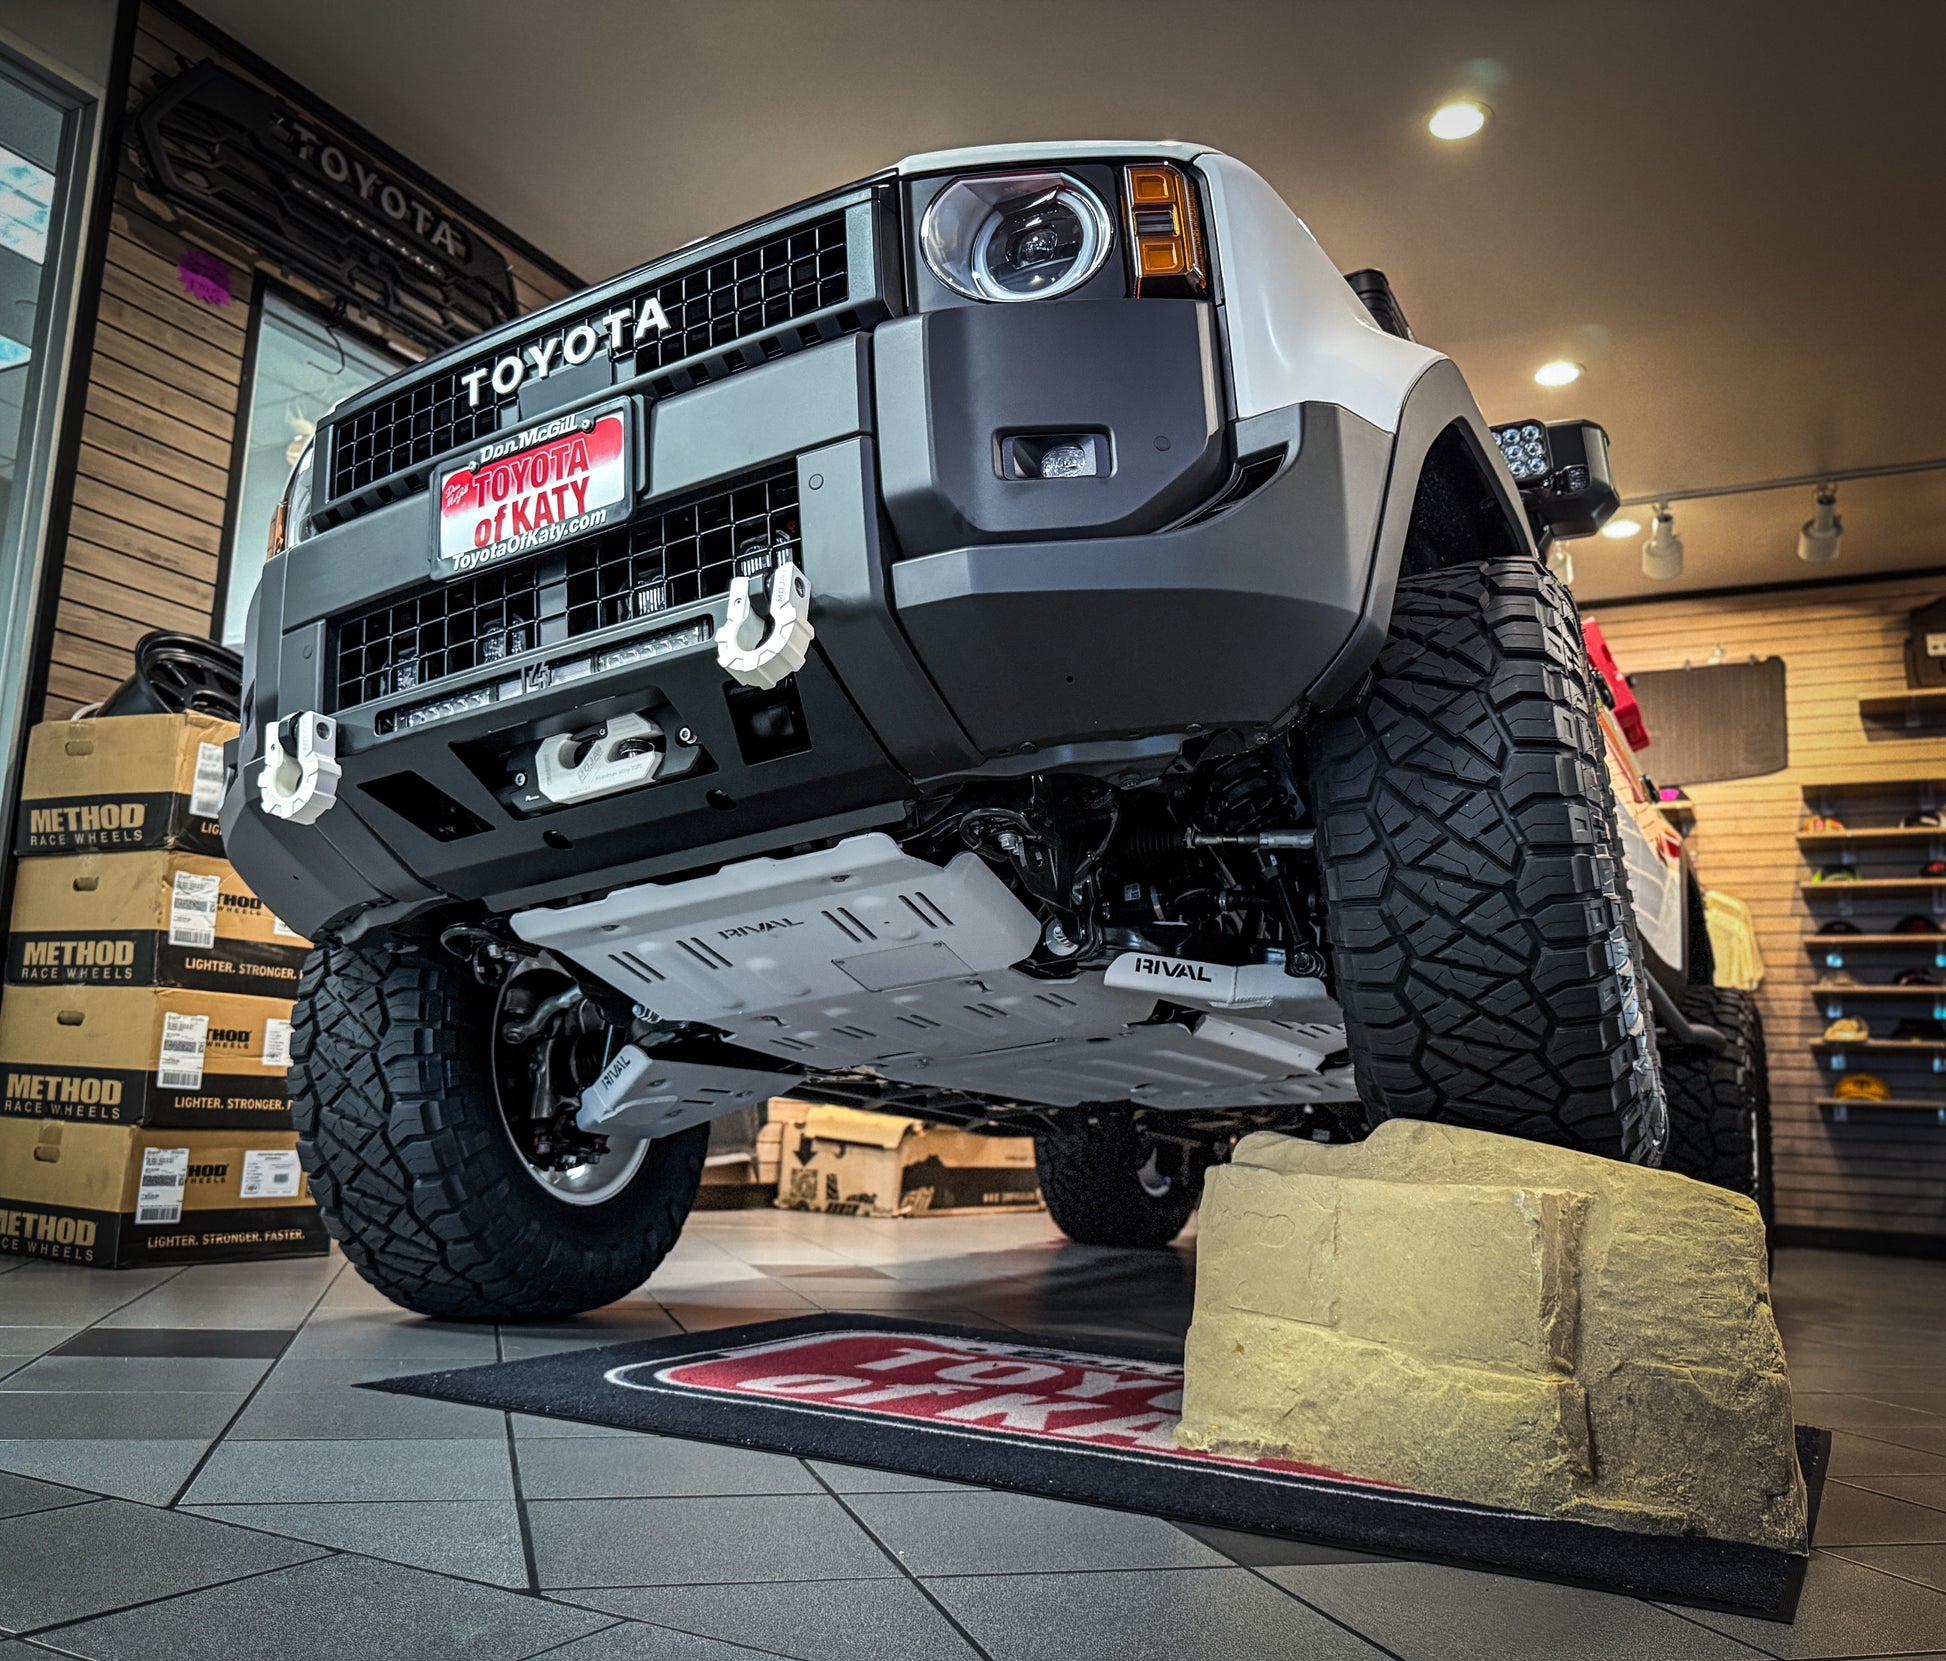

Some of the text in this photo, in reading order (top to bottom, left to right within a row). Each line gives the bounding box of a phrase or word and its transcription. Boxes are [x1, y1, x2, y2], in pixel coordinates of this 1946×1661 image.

[292, 122, 460, 257] TOYOTA
[461, 297, 672, 408] TOYOTA
[480, 414, 578, 464] Don McGill
[472, 437, 591, 510] TOYOTA
[473, 503, 506, 549] of
[511, 475, 591, 537] KATY
[452, 509, 607, 572] ToyotaOfKaty.com
[30, 803, 145, 833] METHOD
[30, 829, 143, 847] RACE WHEELS
[216, 893, 262, 909] THOD
[717, 917, 804, 940] RIVAL
[23, 940, 135, 966] METHOD
[21, 965, 133, 979] RACE WHEELS
[185, 957, 236, 974] LIGHTER.
[239, 963, 297, 980] STRONGER.
[1135, 957, 1212, 983] RIVAL
[206, 1028, 251, 1043] THOD
[601, 1056, 631, 1090] RIVAL
[6, 1073, 122, 1105] METHOD
[4, 1100, 120, 1119] RACE WHEELS
[174, 1096, 224, 1109] LIGHTER.
[227, 1097, 284, 1111] STRONGER.
[27, 1241, 94, 1262] WHEELS
[147, 1228, 305, 1249] LIGHTER. STRONGER. FASTER.
[938, 1392, 1188, 1450] KA
